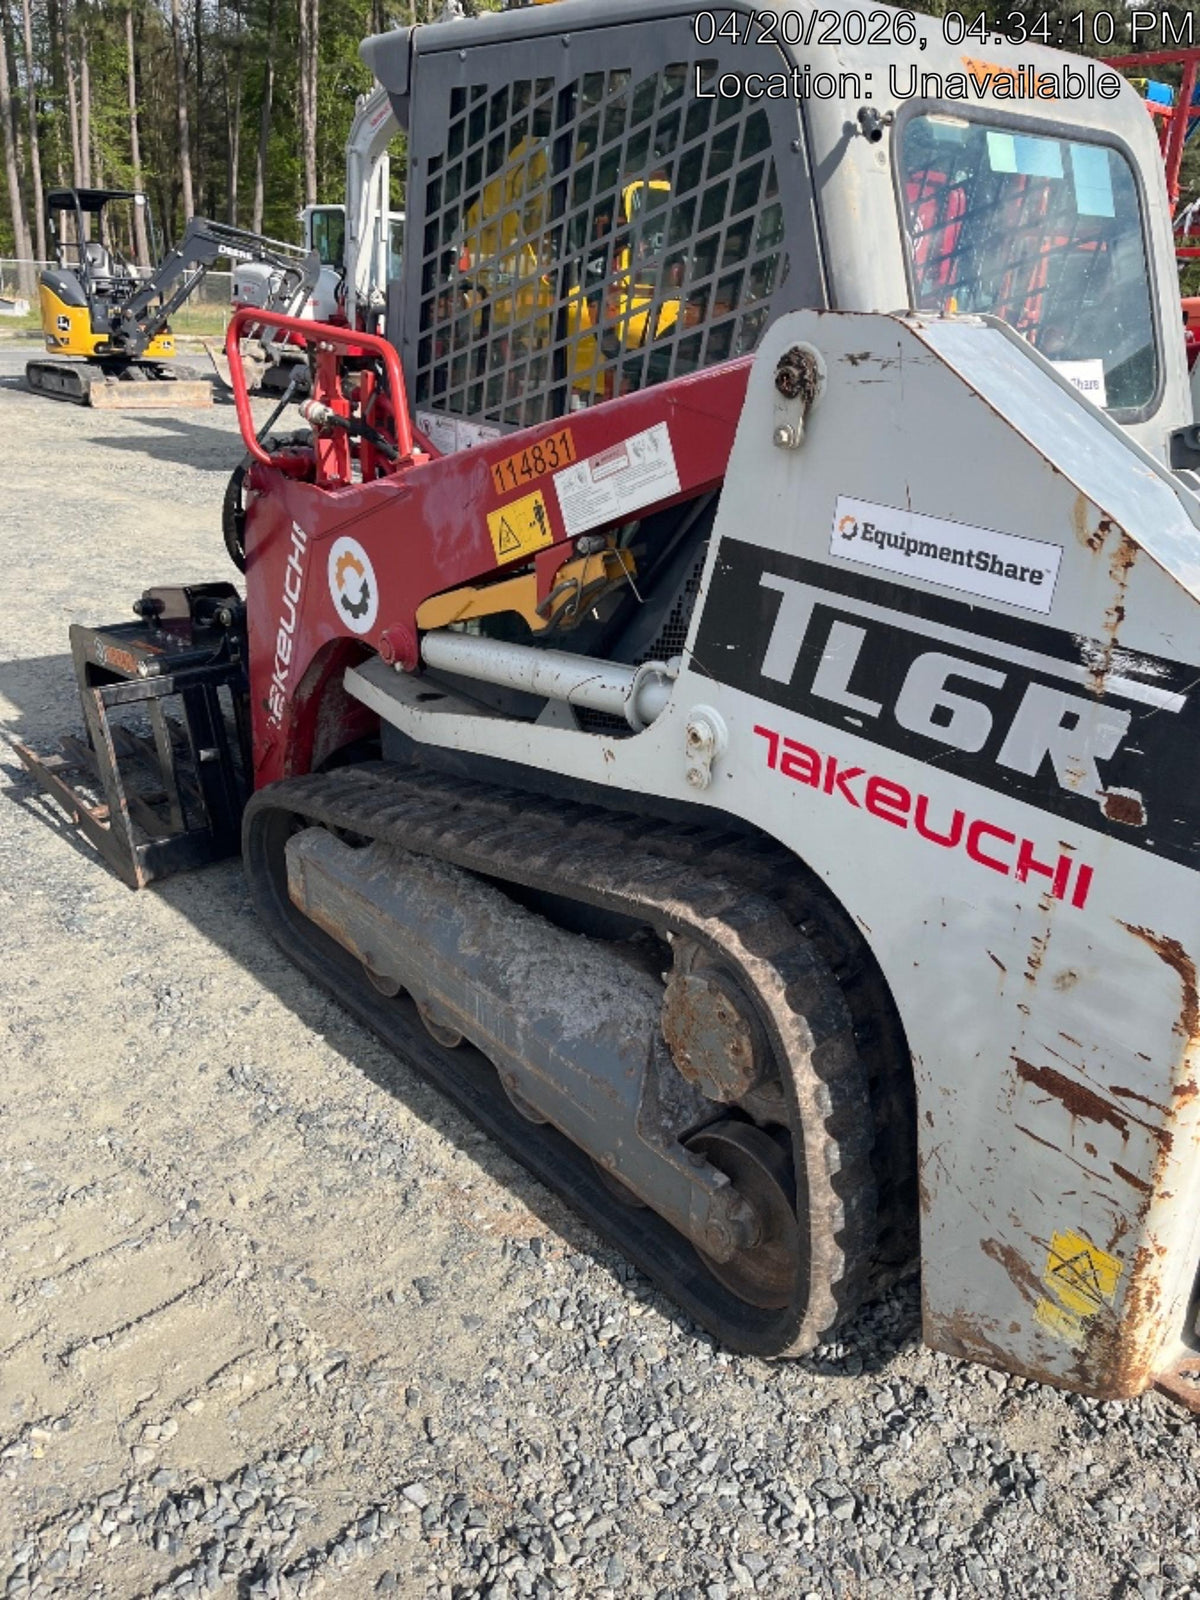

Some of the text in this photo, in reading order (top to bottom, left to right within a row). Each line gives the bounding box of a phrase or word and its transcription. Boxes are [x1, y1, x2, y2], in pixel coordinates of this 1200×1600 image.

[218, 244, 253, 260] DEERE
[495, 431, 572, 492] 114831
[758, 571, 1188, 804] TL6R
